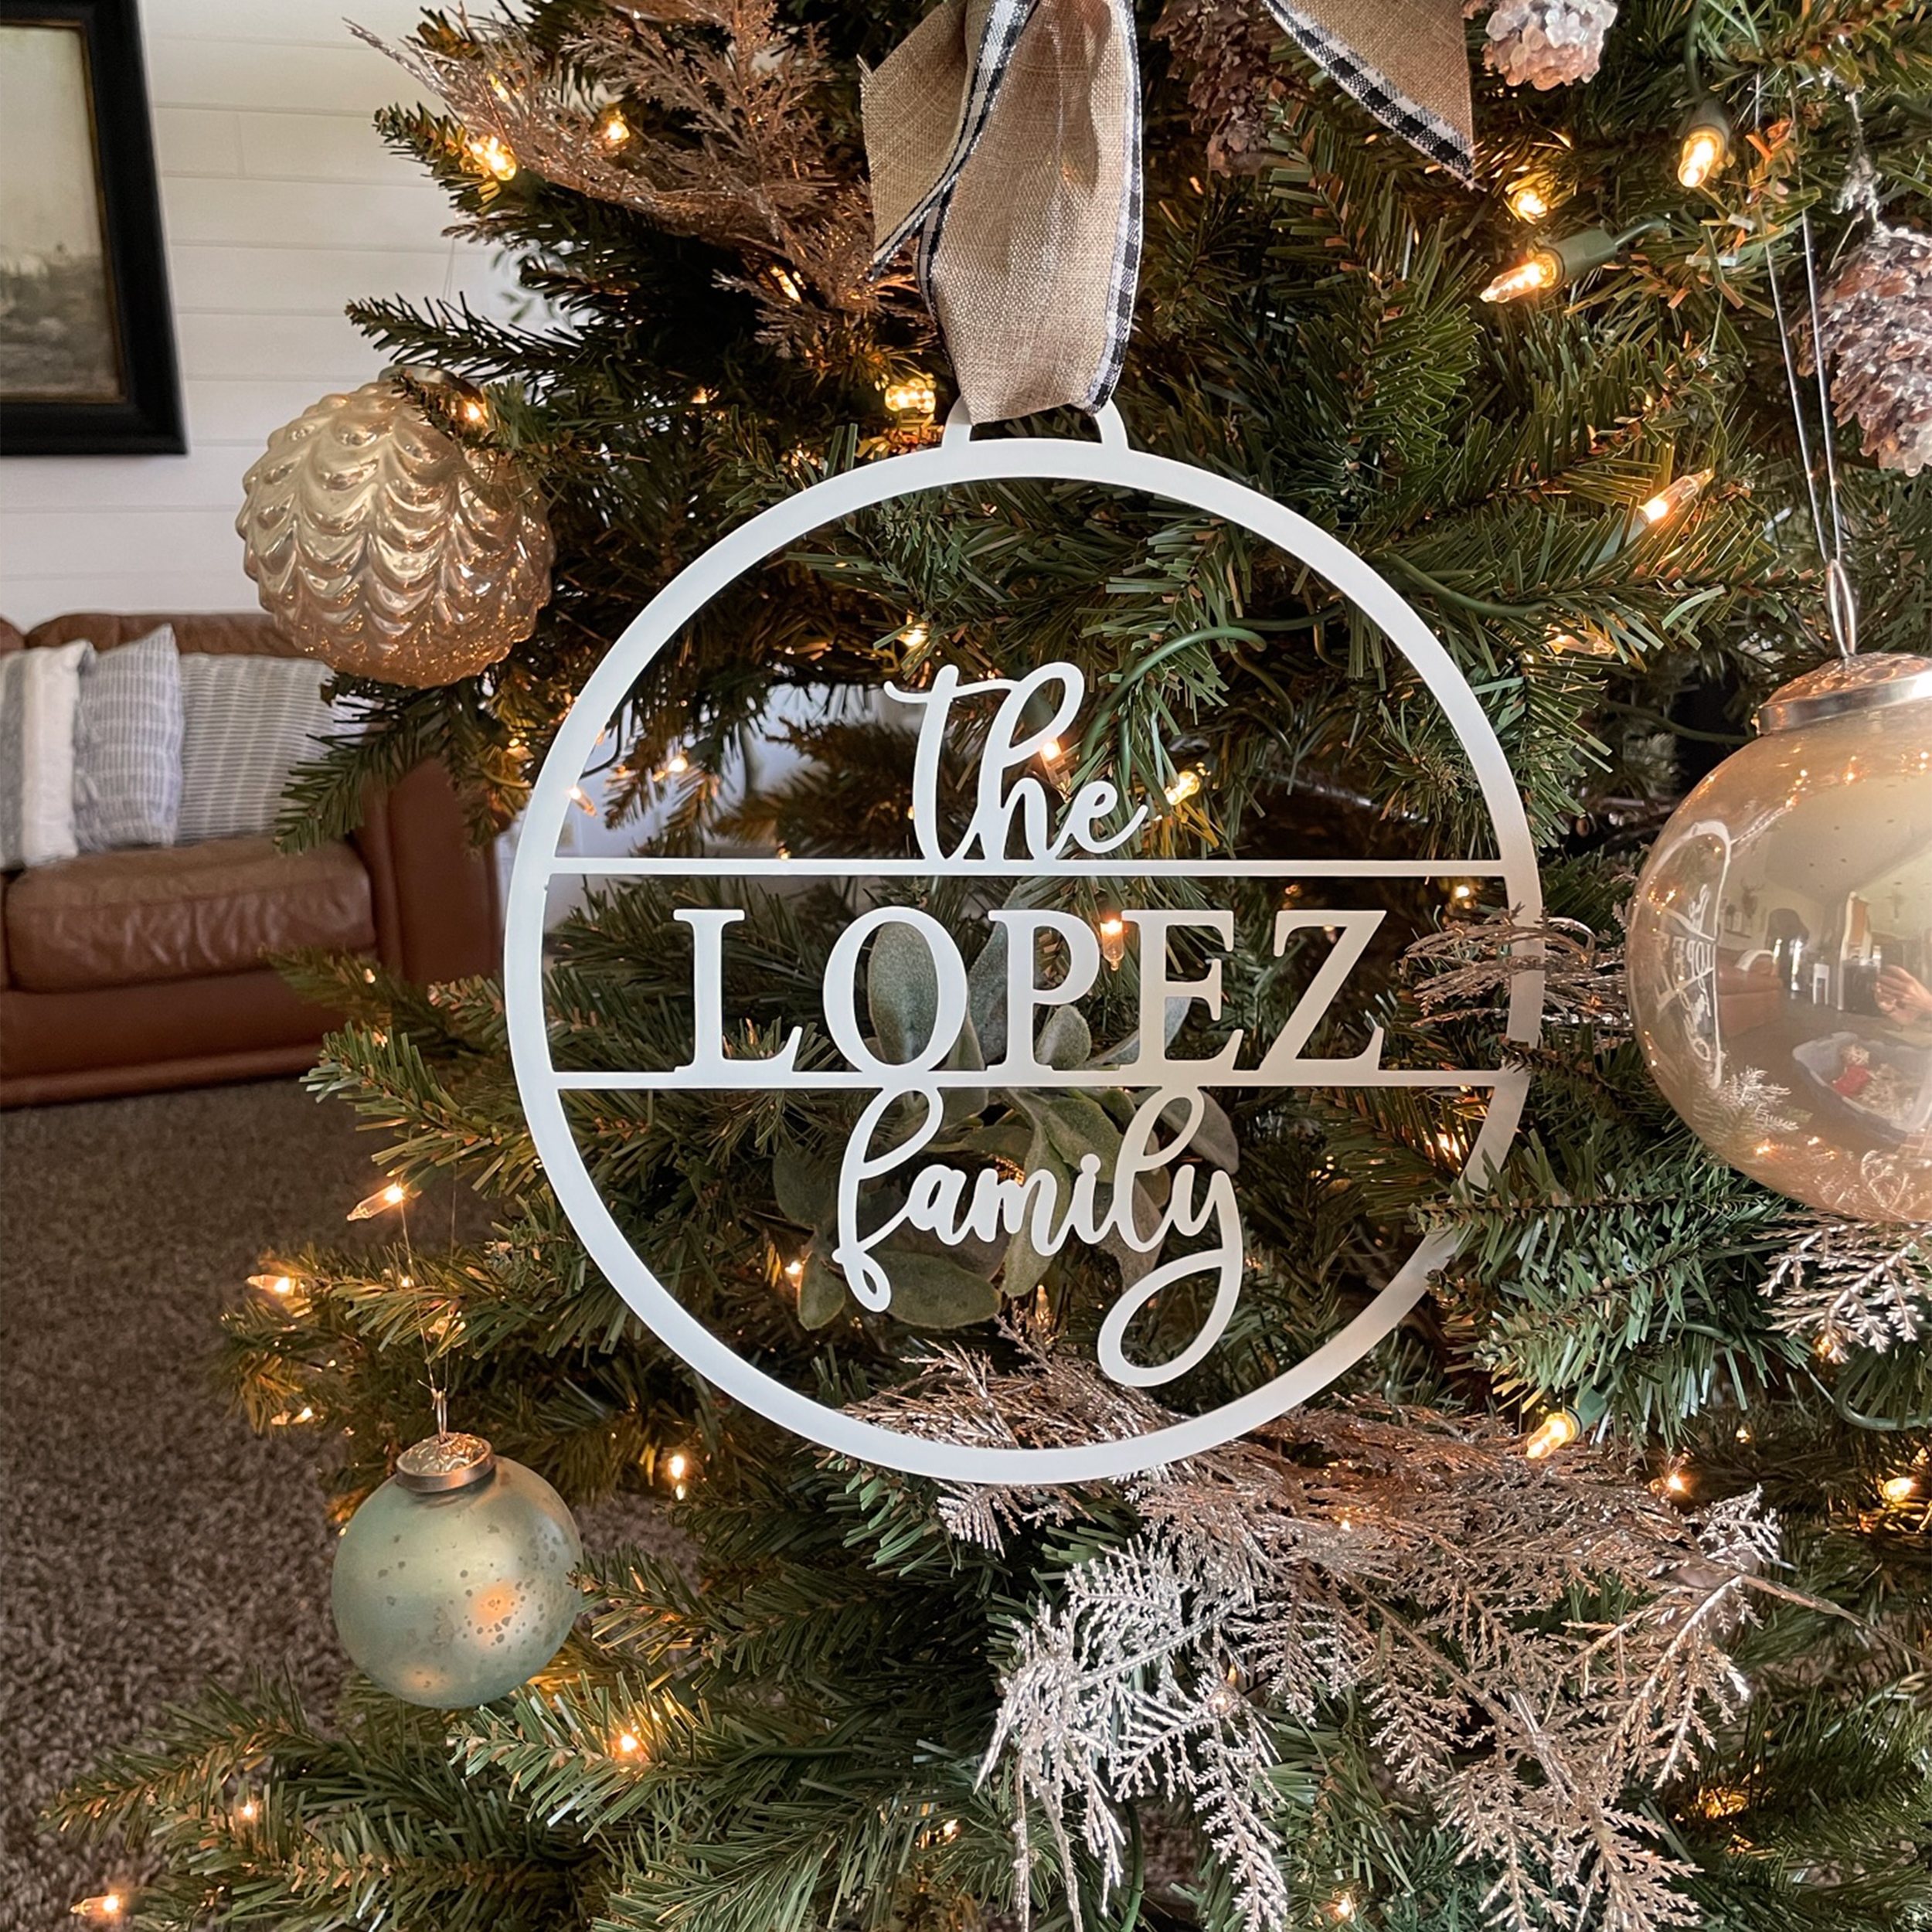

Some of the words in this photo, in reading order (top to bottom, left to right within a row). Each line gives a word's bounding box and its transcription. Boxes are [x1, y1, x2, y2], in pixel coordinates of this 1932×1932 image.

[884, 662, 1148, 859] the
[673, 906, 1388, 1073] LOPEZ
[832, 1087, 1241, 1387] family
